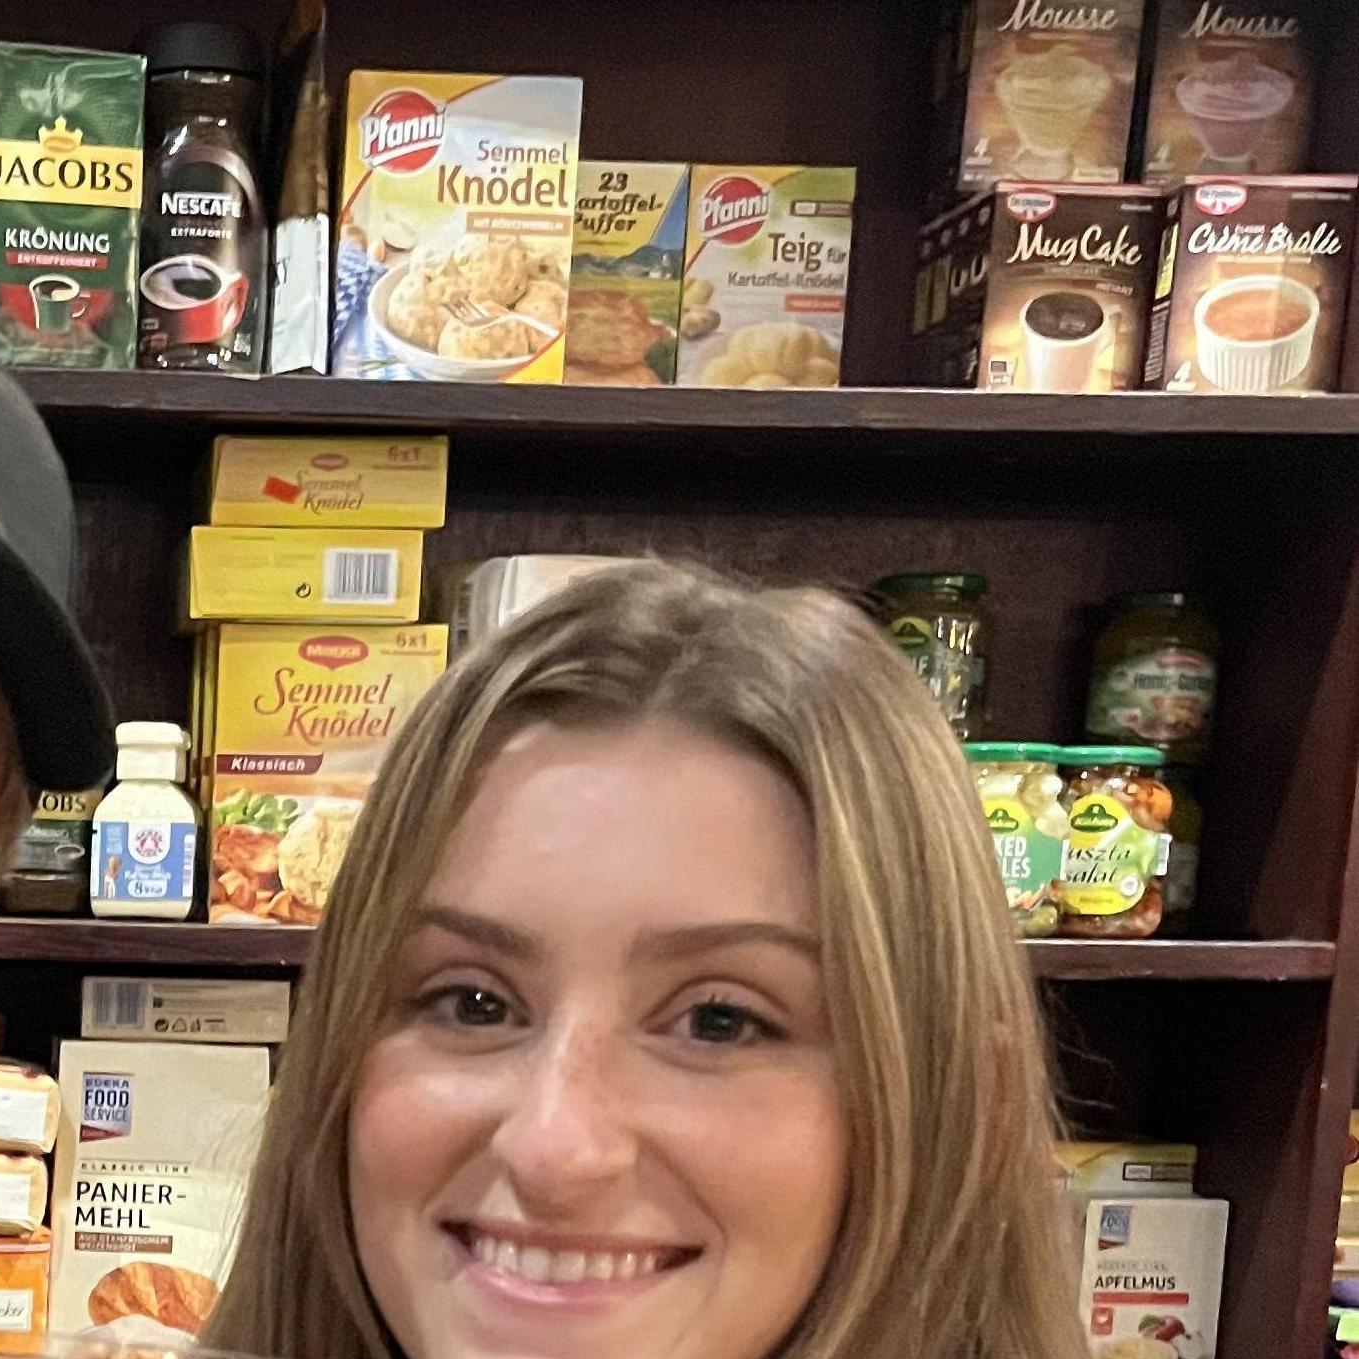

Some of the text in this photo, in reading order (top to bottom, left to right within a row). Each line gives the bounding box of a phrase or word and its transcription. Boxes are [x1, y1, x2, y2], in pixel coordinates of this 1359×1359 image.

[1183, 2, 1302, 41] Mousse
[362, 110, 446, 160] Pfanni
[477, 139, 569, 165] Semmel
[437, 164, 569, 209] Knödel
[599, 171, 629, 193] 23
[700, 188, 771, 229] Pfanni
[5, 226, 111, 254] KRÖNUNG
[768, 232, 824, 273] Teig
[1006, 222, 1143, 268] Mug Cake
[395, 631, 428, 649] 6x1
[253, 667, 394, 716] Semmel
[284, 704, 396, 746] Knödel
[85, 1077, 130, 1089] EDEKA
[84, 1088, 130, 1108] FOOD
[83, 1107, 128, 1122] SERVICE
[80, 1162, 190, 1174] CLASSIC LINE
[76, 1180, 187, 1205] PANIER-
[74, 1205, 151, 1229] MEHL
[1093, 1275, 1176, 1290] APFELMUS
